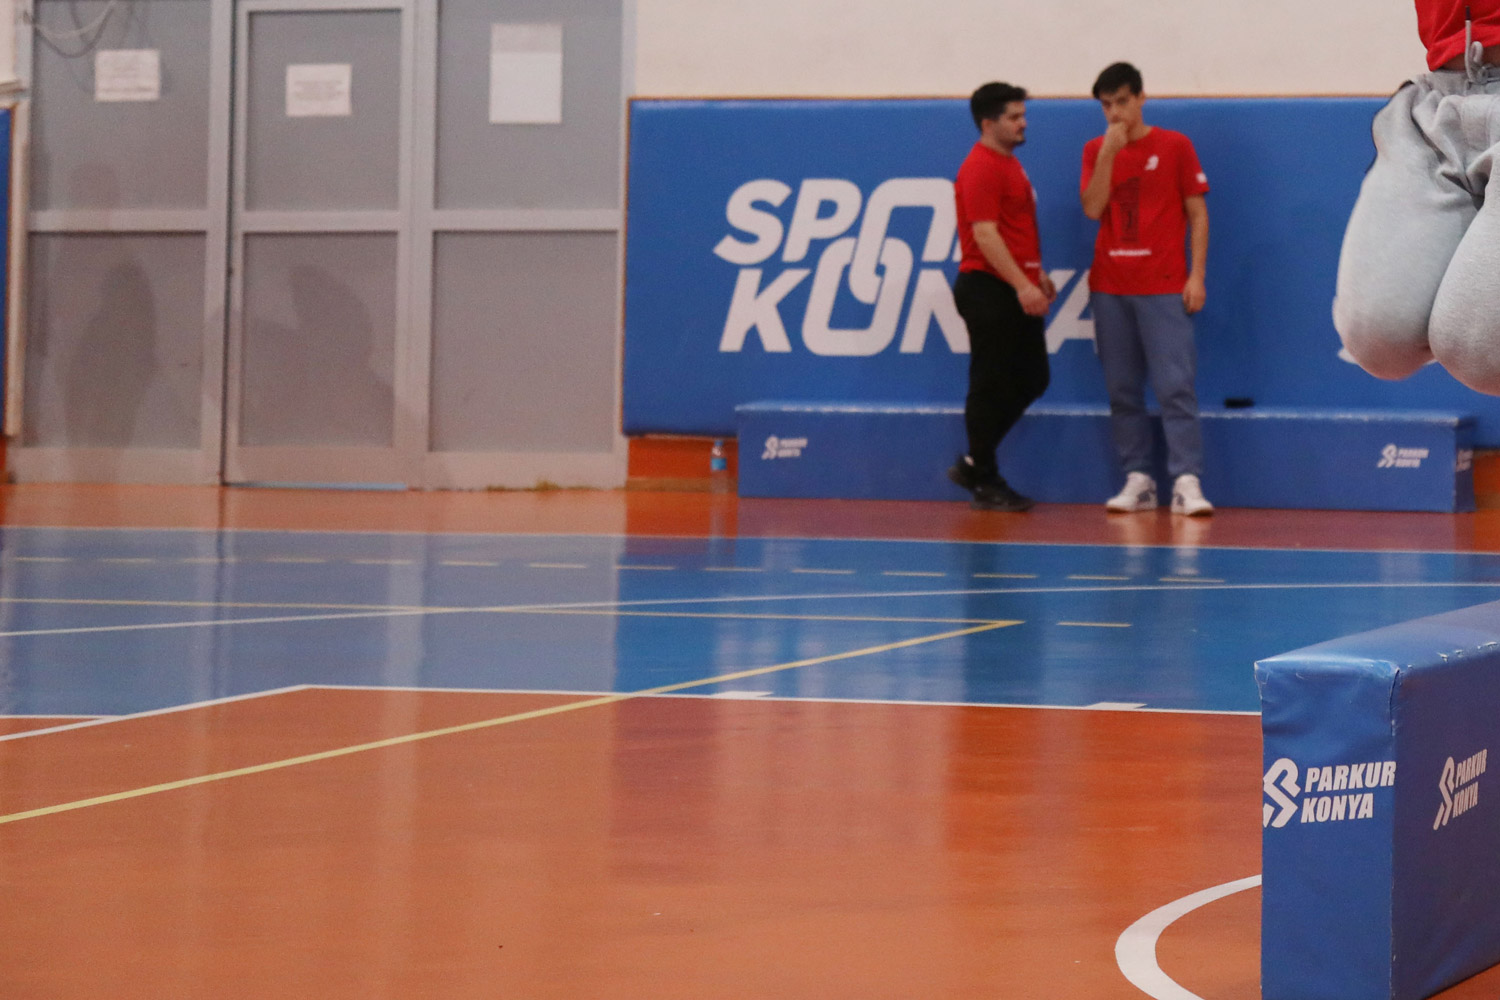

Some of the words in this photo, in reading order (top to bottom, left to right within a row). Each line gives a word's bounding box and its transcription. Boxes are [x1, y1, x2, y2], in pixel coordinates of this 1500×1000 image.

[712, 177, 962, 304] SPO
[1305, 761, 1397, 793] PARKUR
[1455, 748, 1487, 788] PARKUR
[1300, 793, 1374, 823] KONYA
[1453, 781, 1479, 819] KONYA
